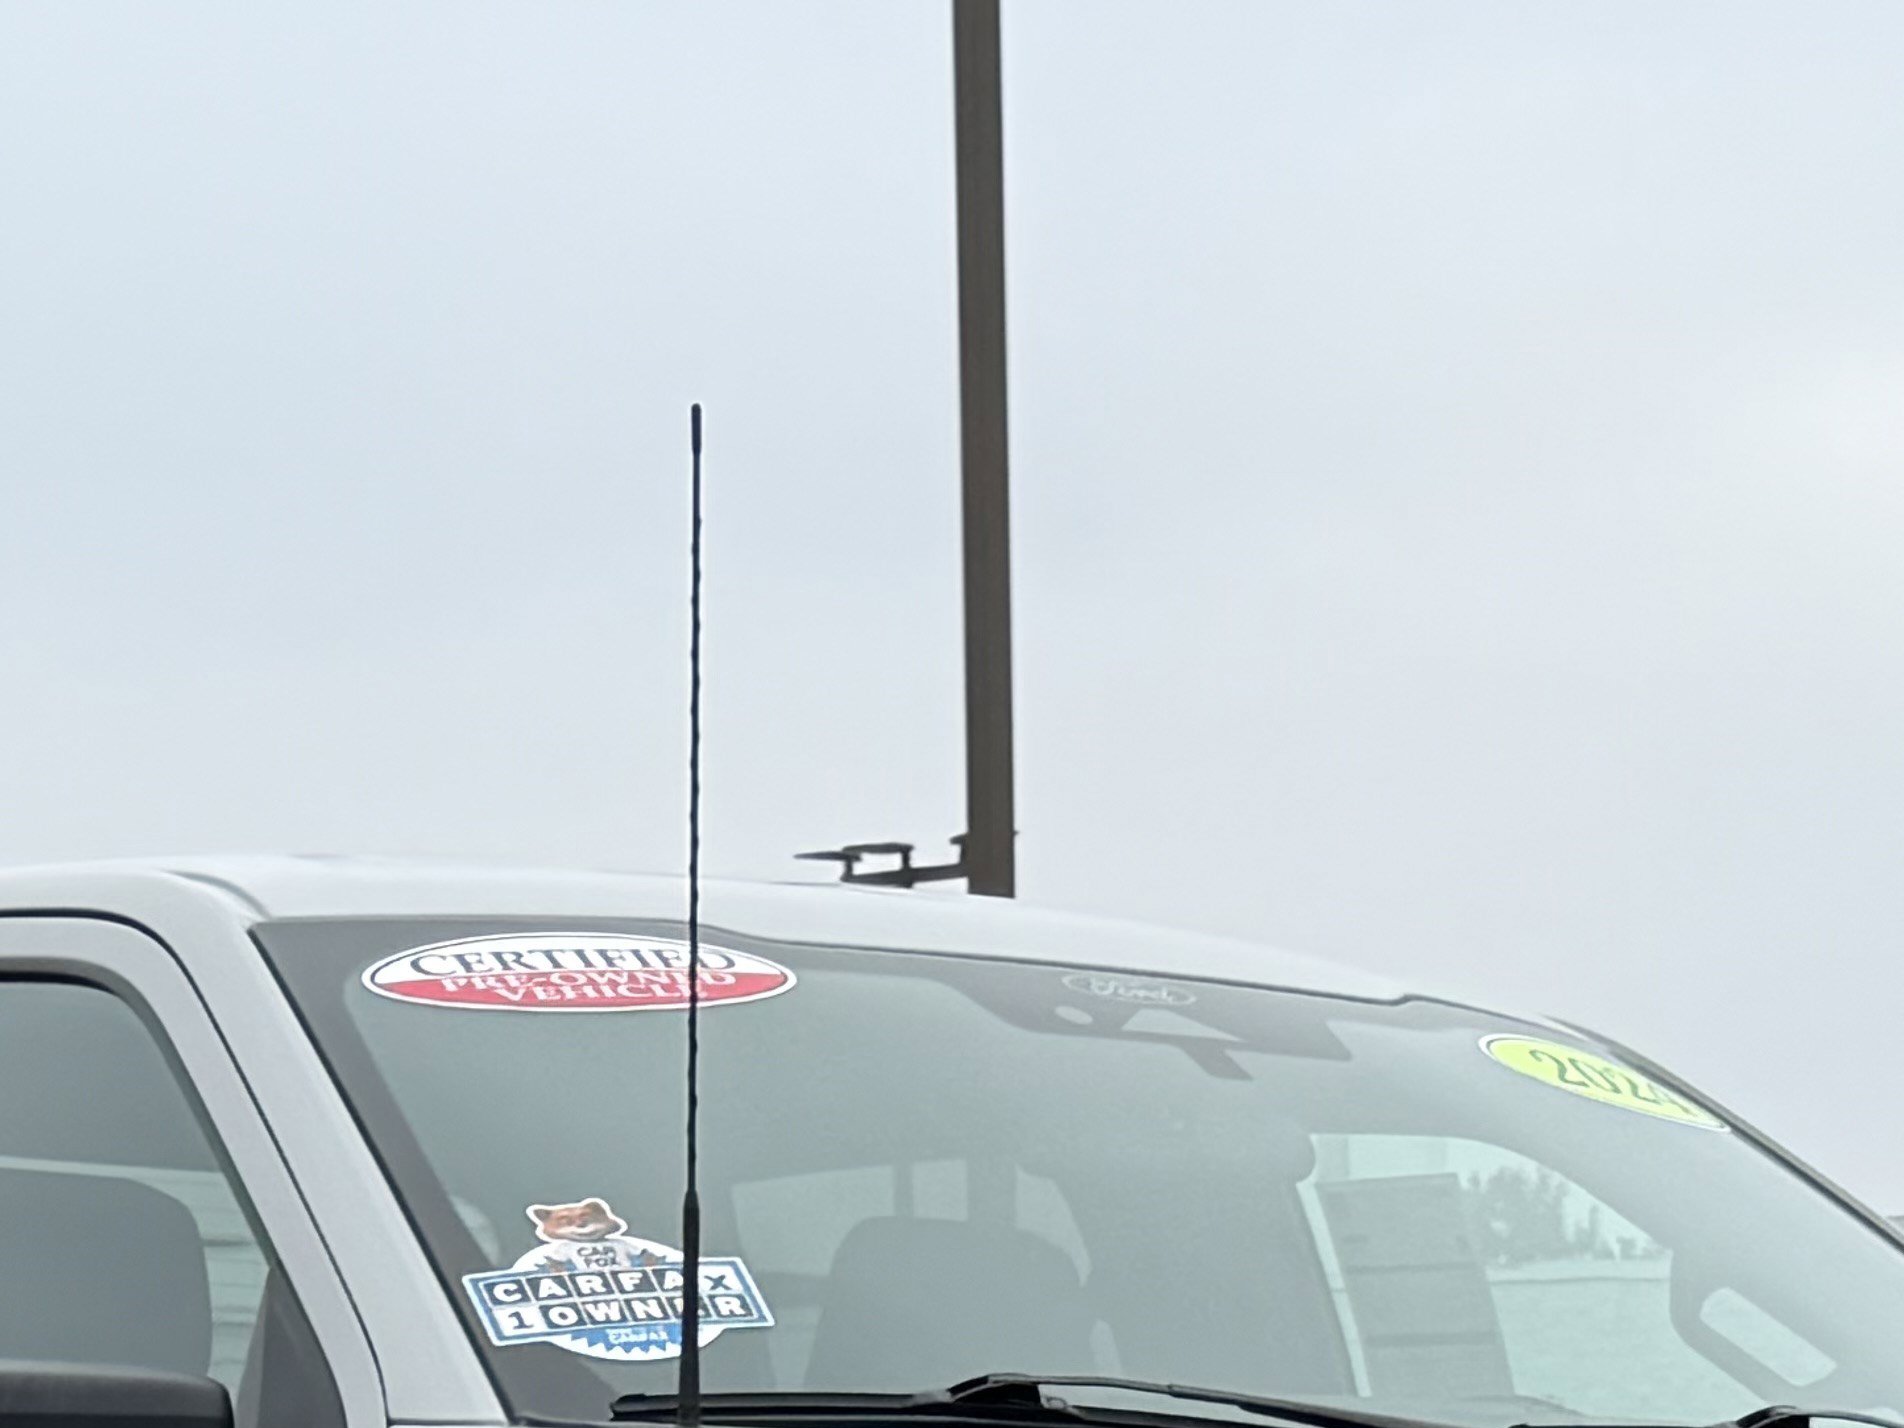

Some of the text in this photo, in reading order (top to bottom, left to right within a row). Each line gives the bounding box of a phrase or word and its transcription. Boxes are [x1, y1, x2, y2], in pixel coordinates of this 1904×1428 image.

[409, 948, 737, 977] CERTIFIED
[492, 1269, 734, 1303] CARFAX
[507, 1311, 535, 1331] 1
